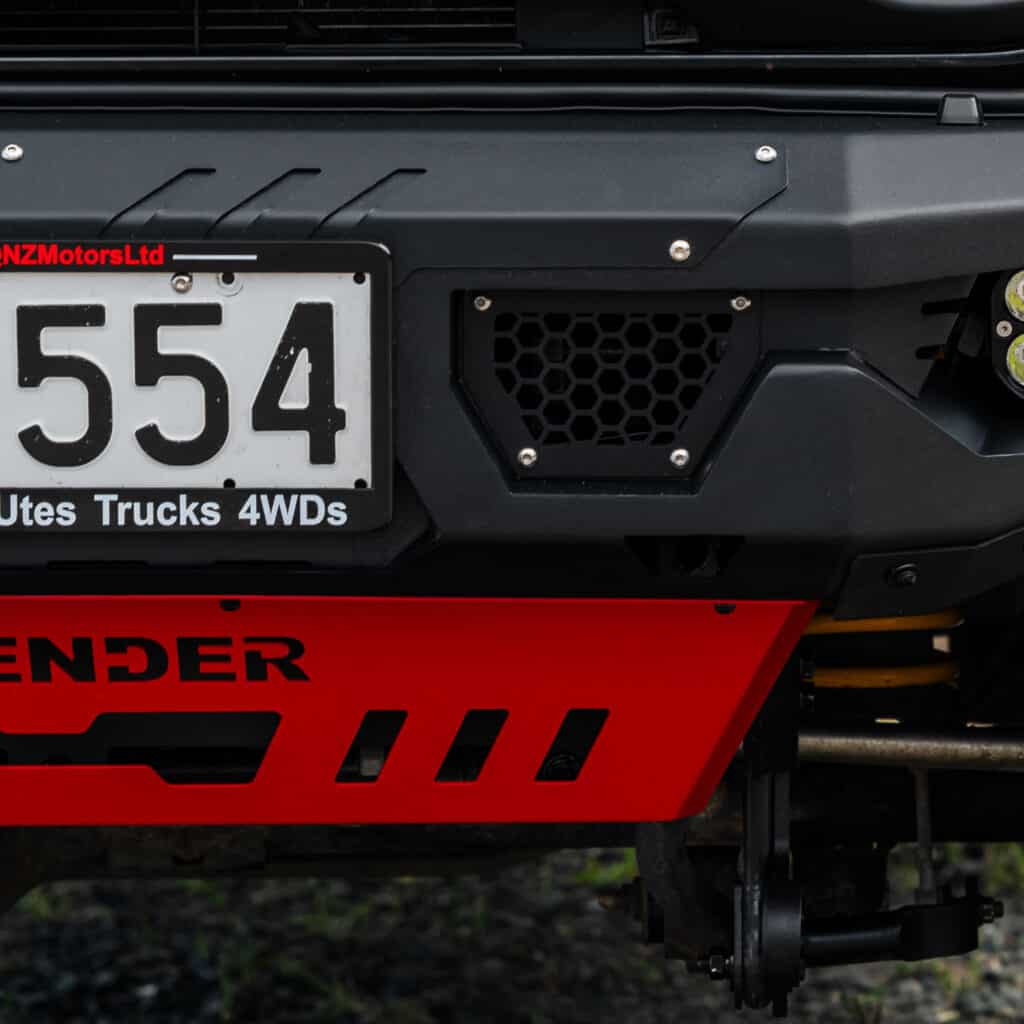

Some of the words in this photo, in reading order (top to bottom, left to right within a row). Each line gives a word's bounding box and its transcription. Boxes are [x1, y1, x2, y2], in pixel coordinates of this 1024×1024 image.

[0, 243, 165, 268] NZMotorsLtd
[16, 302, 346, 466] 554
[0, 494, 76, 526] Utes
[94, 494, 221, 526] Trucks
[238, 494, 348, 526] 4WDs
